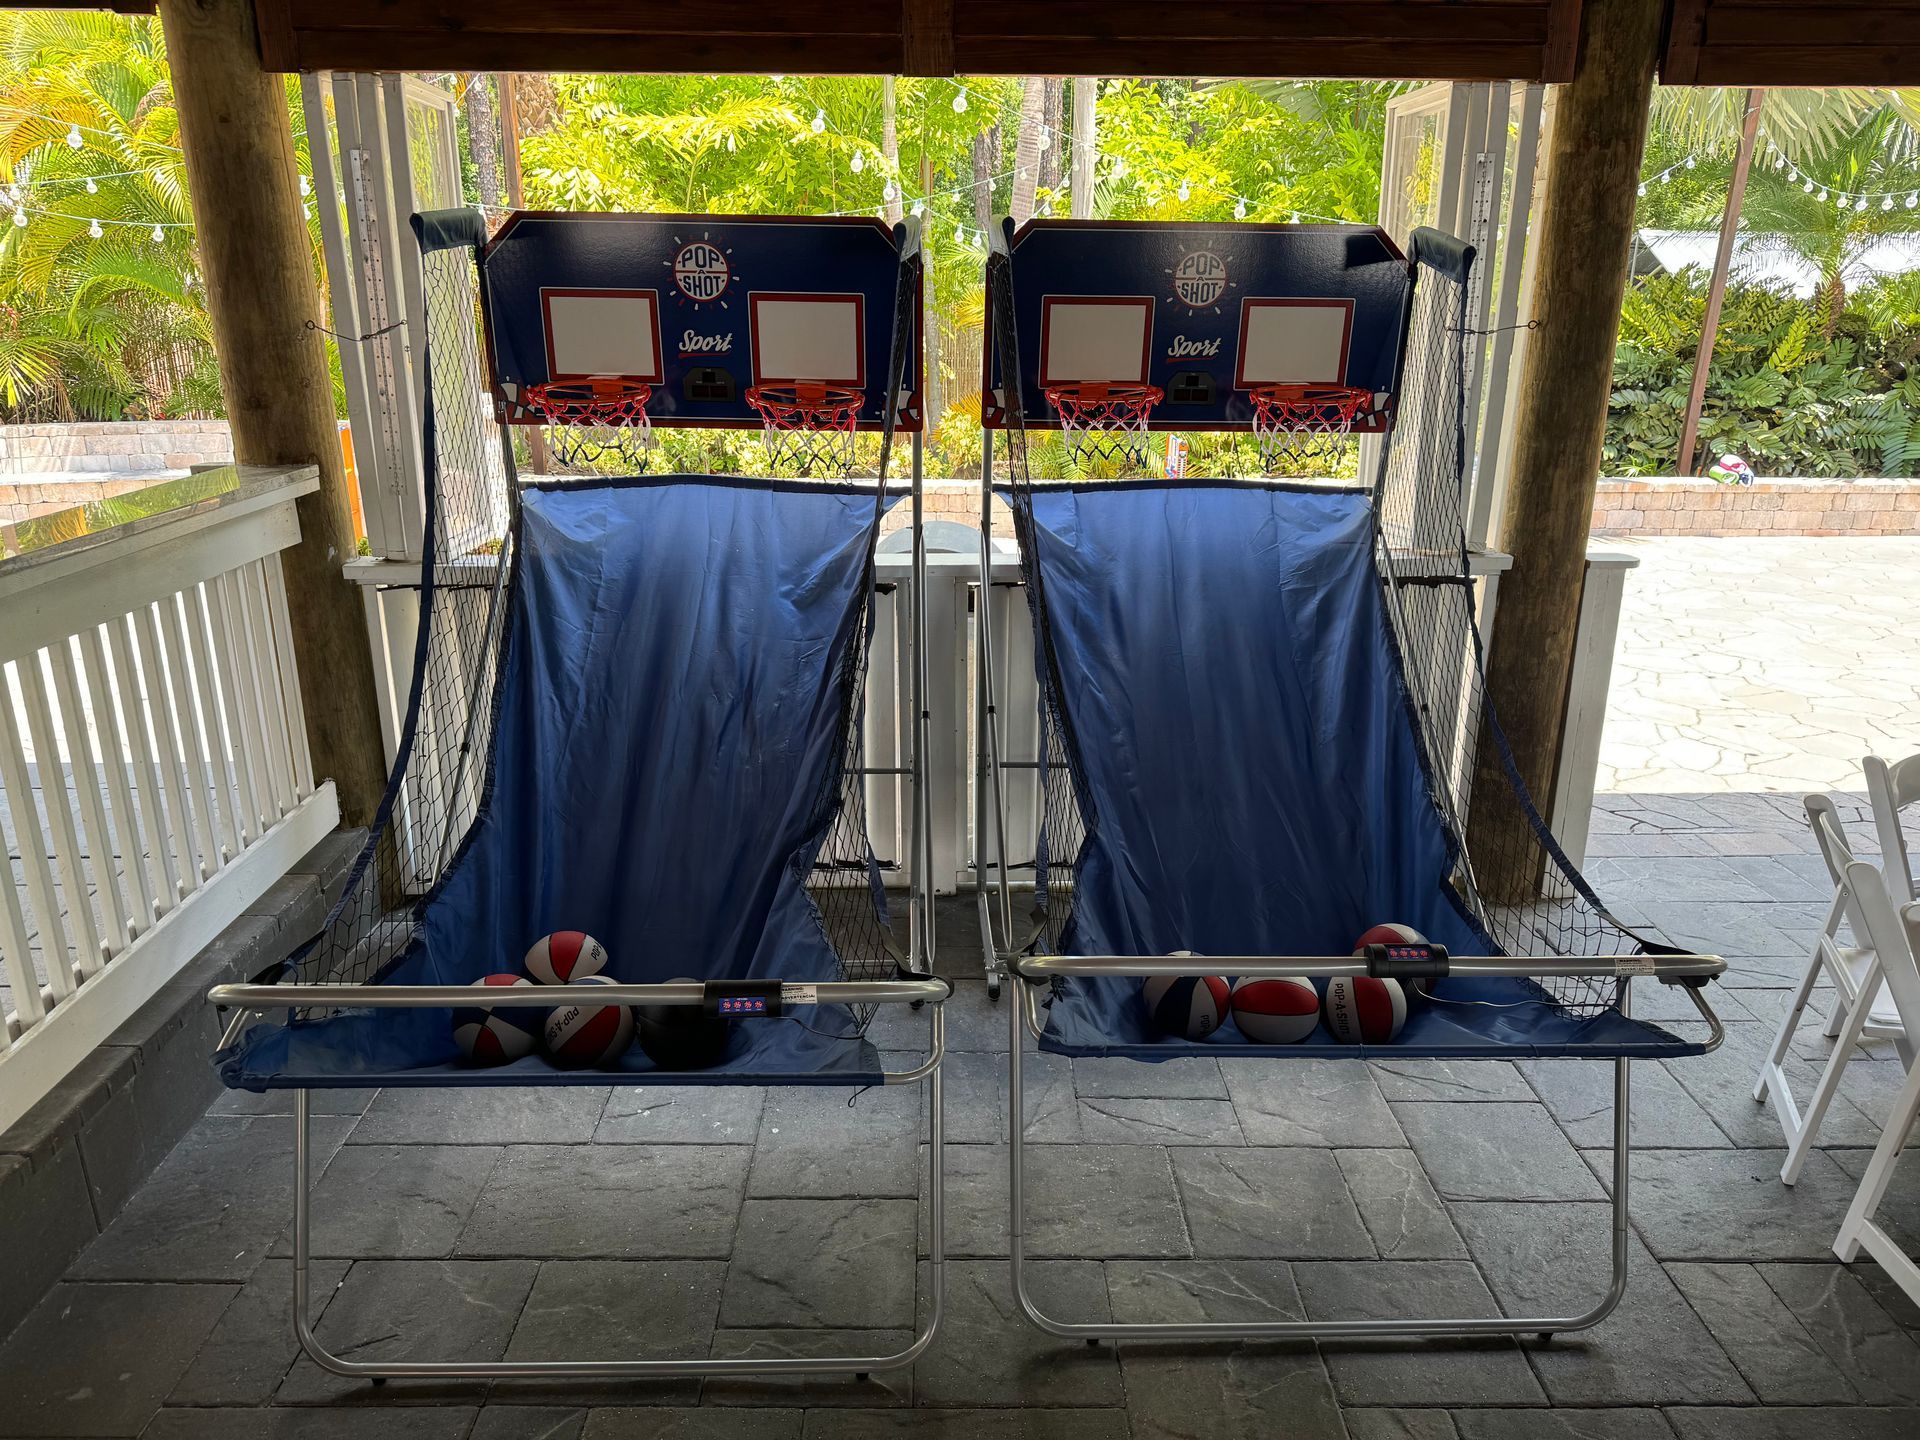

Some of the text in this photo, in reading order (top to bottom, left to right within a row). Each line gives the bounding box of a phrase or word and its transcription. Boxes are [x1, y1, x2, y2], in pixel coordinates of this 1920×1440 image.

[681, 246, 720, 269] POP
[1183, 253, 1220, 276] POP
[683, 275, 721, 298] SHOT
[1181, 282, 1218, 304] SHOT
[678, 329, 733, 352] Sport
[1167, 334, 1222, 358] Sport
